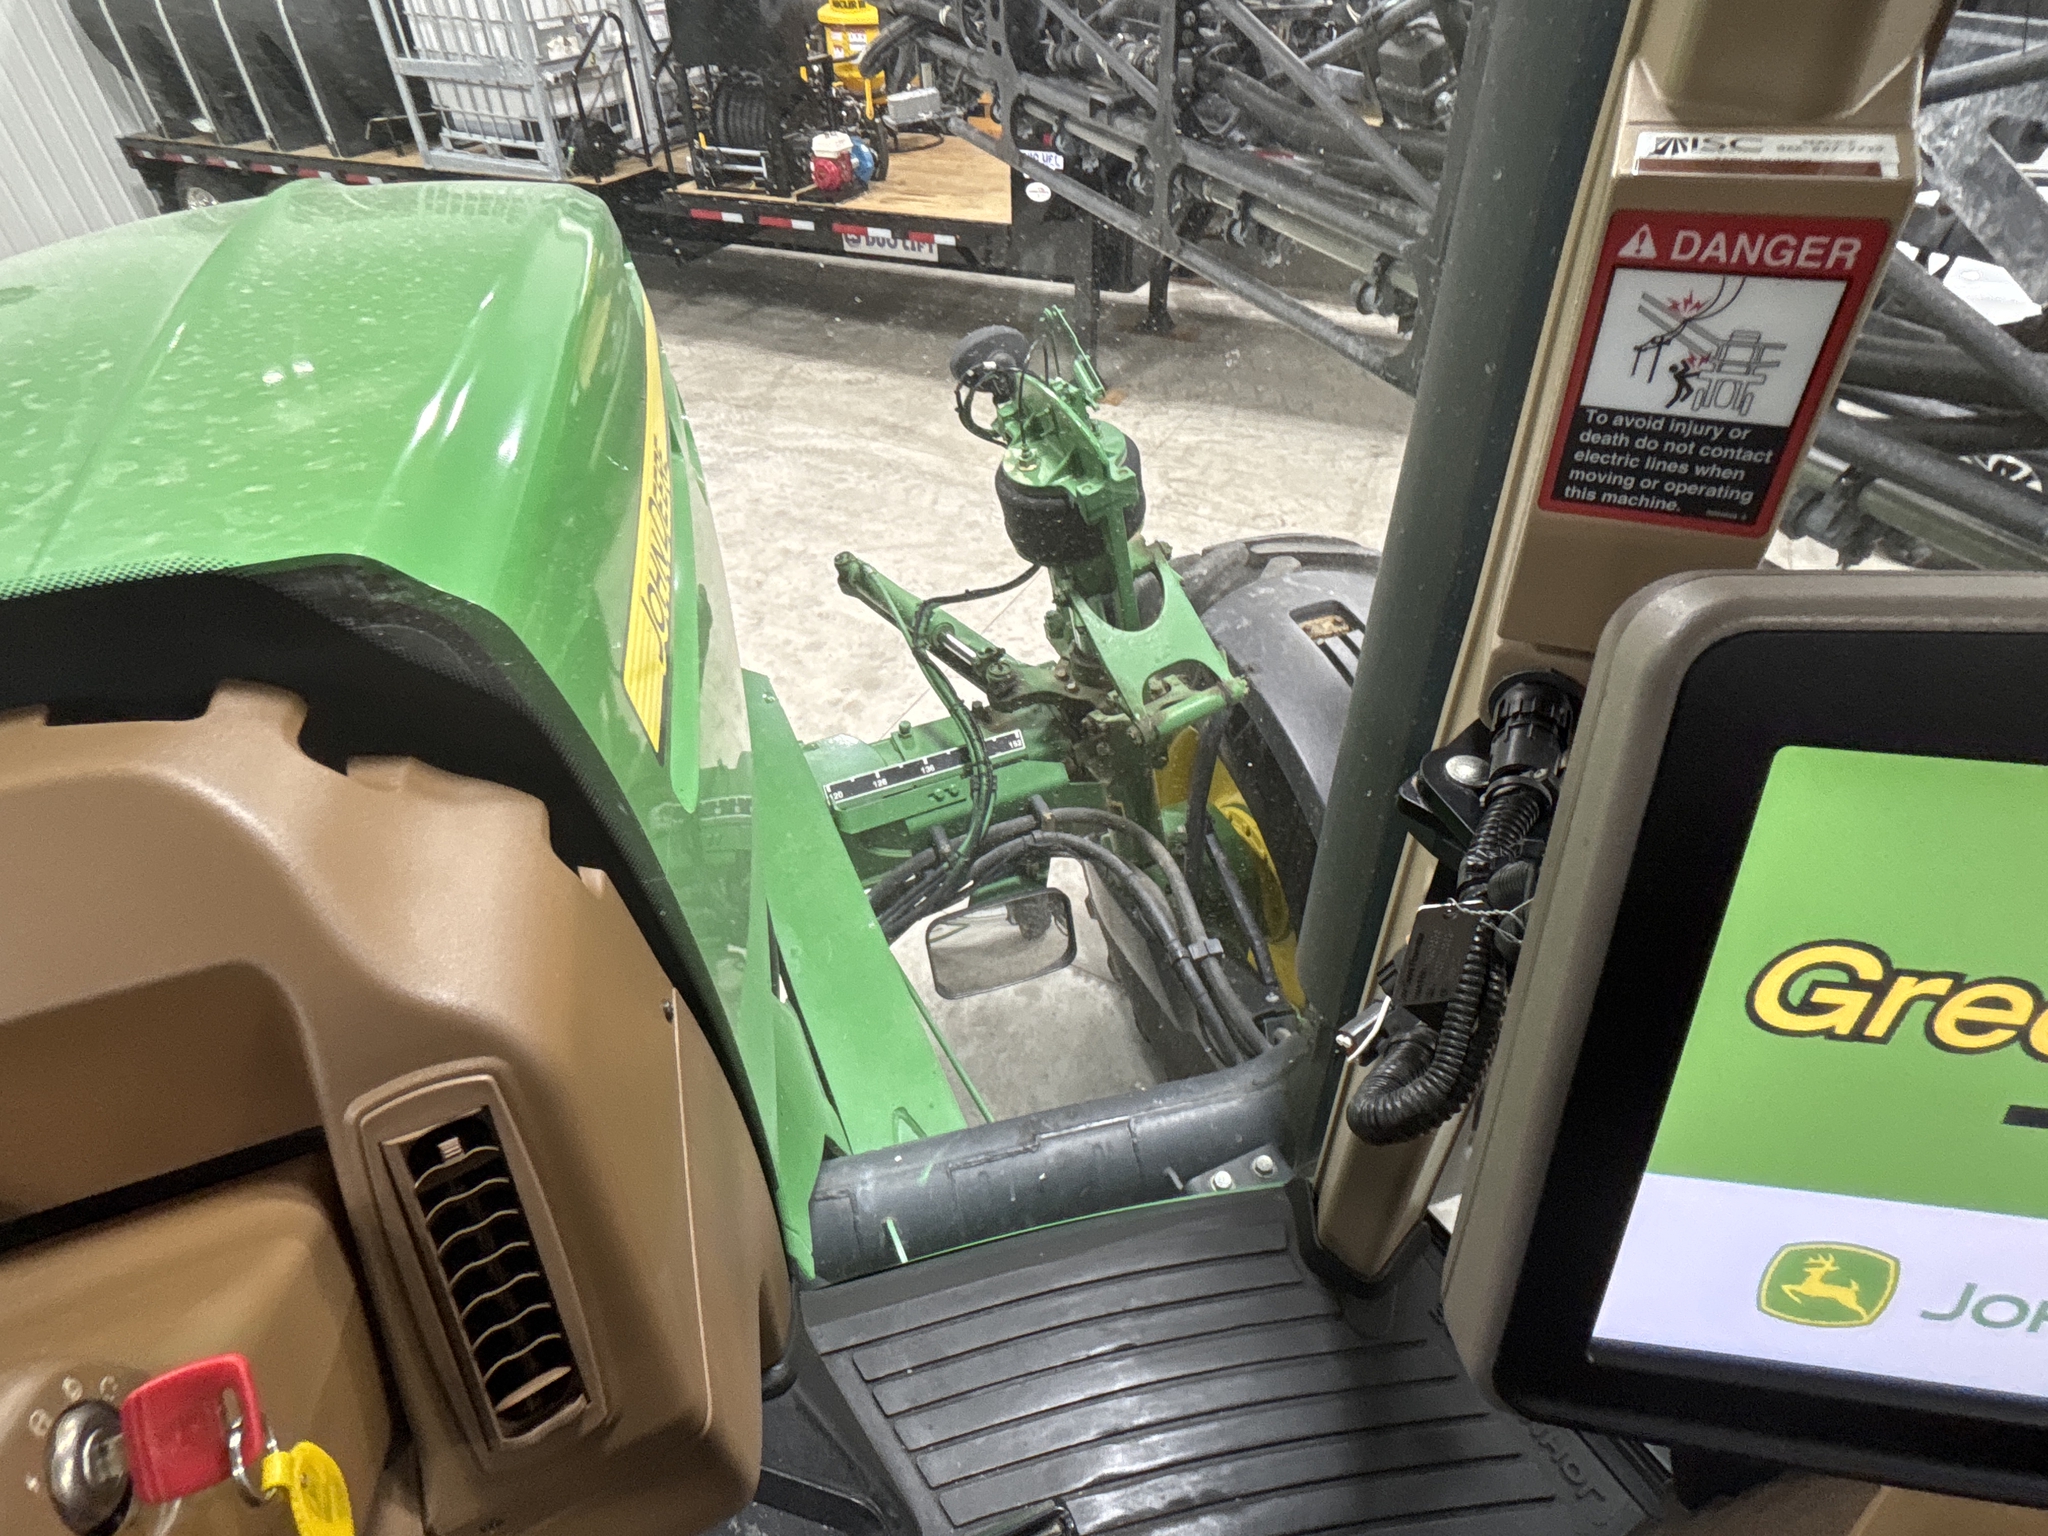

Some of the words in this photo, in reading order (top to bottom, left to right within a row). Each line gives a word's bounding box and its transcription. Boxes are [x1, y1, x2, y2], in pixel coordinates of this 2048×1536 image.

[902, 238, 934, 254] LIFT
[1670, 229, 1862, 271] DANGER
[1585, 408, 1608, 425] To
[1612, 413, 1665, 432] avoid
[1669, 418, 1724, 441] injury
[1728, 427, 1752, 441] or
[1579, 429, 1630, 448] death
[1635, 435, 1659, 451] do
[1663, 440, 1696, 455] not
[1700, 445, 1774, 464] contact
[1574, 449, 1640, 469] electric
[1644, 456, 1690, 475] lines
[1695, 462, 1745, 481] when
[1564, 485, 1597, 501] this
[1601, 490, 1681, 512] machine.
[1568, 467, 1636, 490] moving
[1640, 477, 1660, 489] or
[1664, 480, 1754, 505] operating
[641, 527, 670, 665] JOHN
[920, 764, 935, 774] 136
[829, 790, 844, 800] 120
